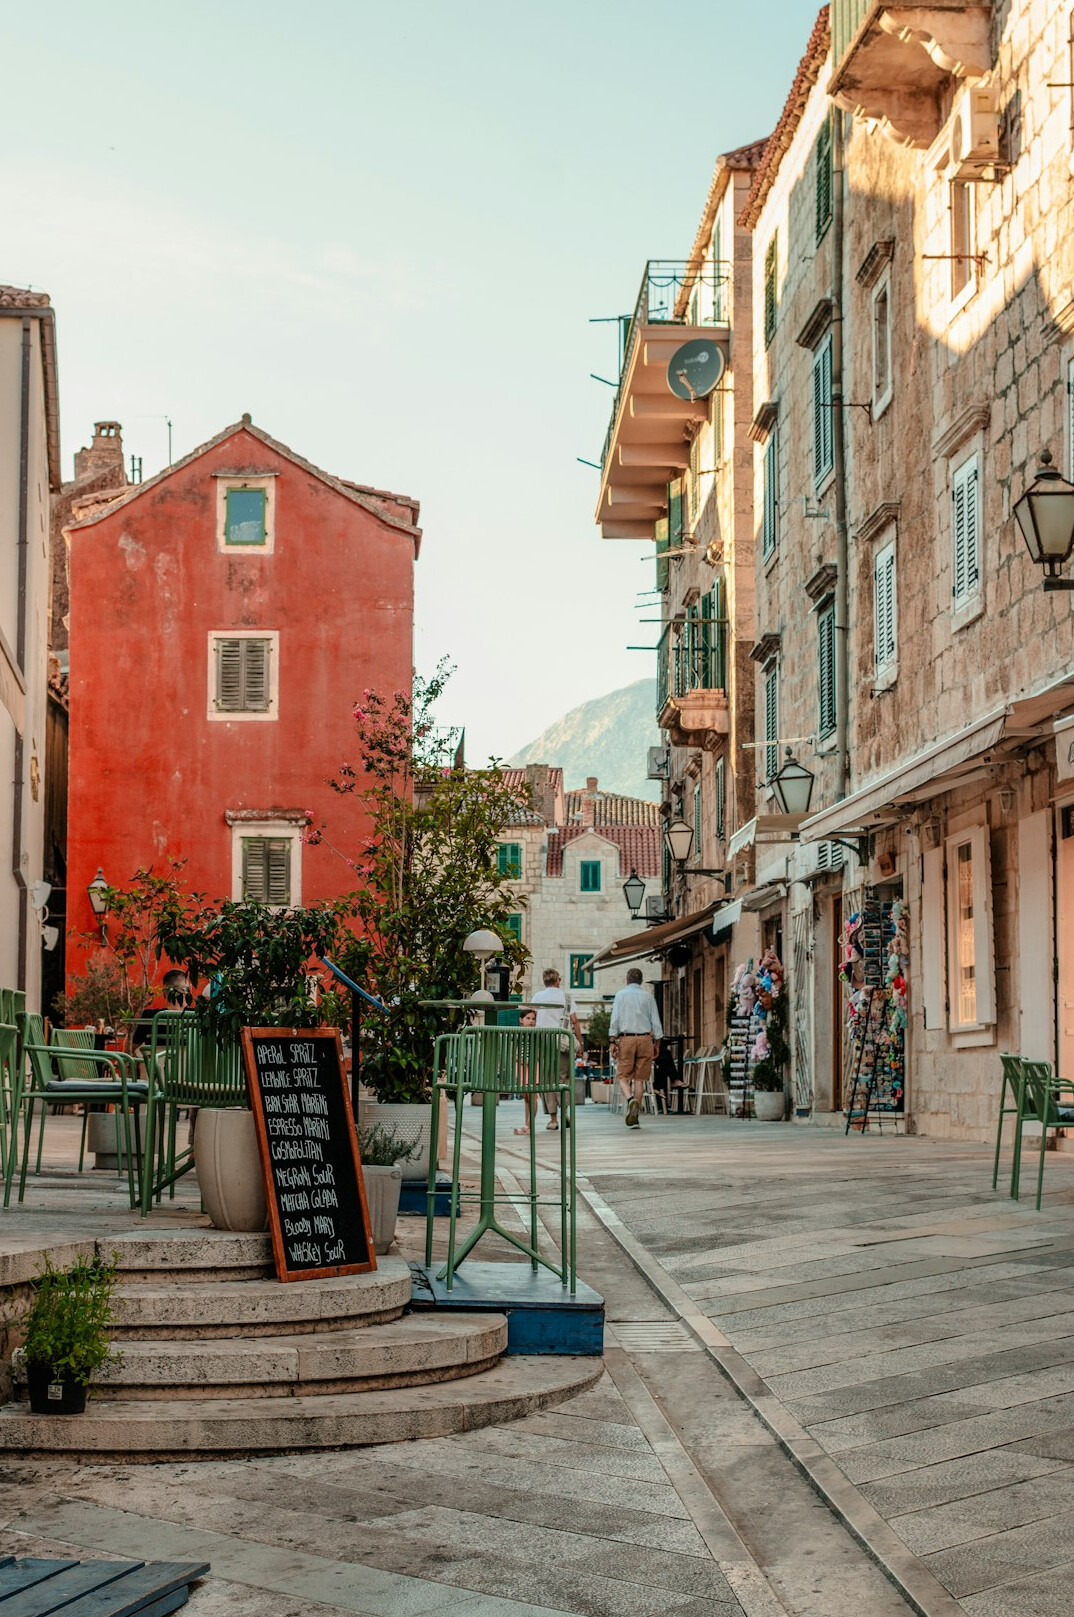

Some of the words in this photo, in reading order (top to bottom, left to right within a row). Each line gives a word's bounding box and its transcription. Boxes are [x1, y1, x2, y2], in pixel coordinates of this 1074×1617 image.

[268, 1117, 303, 1136] ESPRESSO
[312, 1164, 336, 1186] SOUR
[313, 1215, 336, 1239] MARY
[324, 1239, 346, 1262] SOUR
